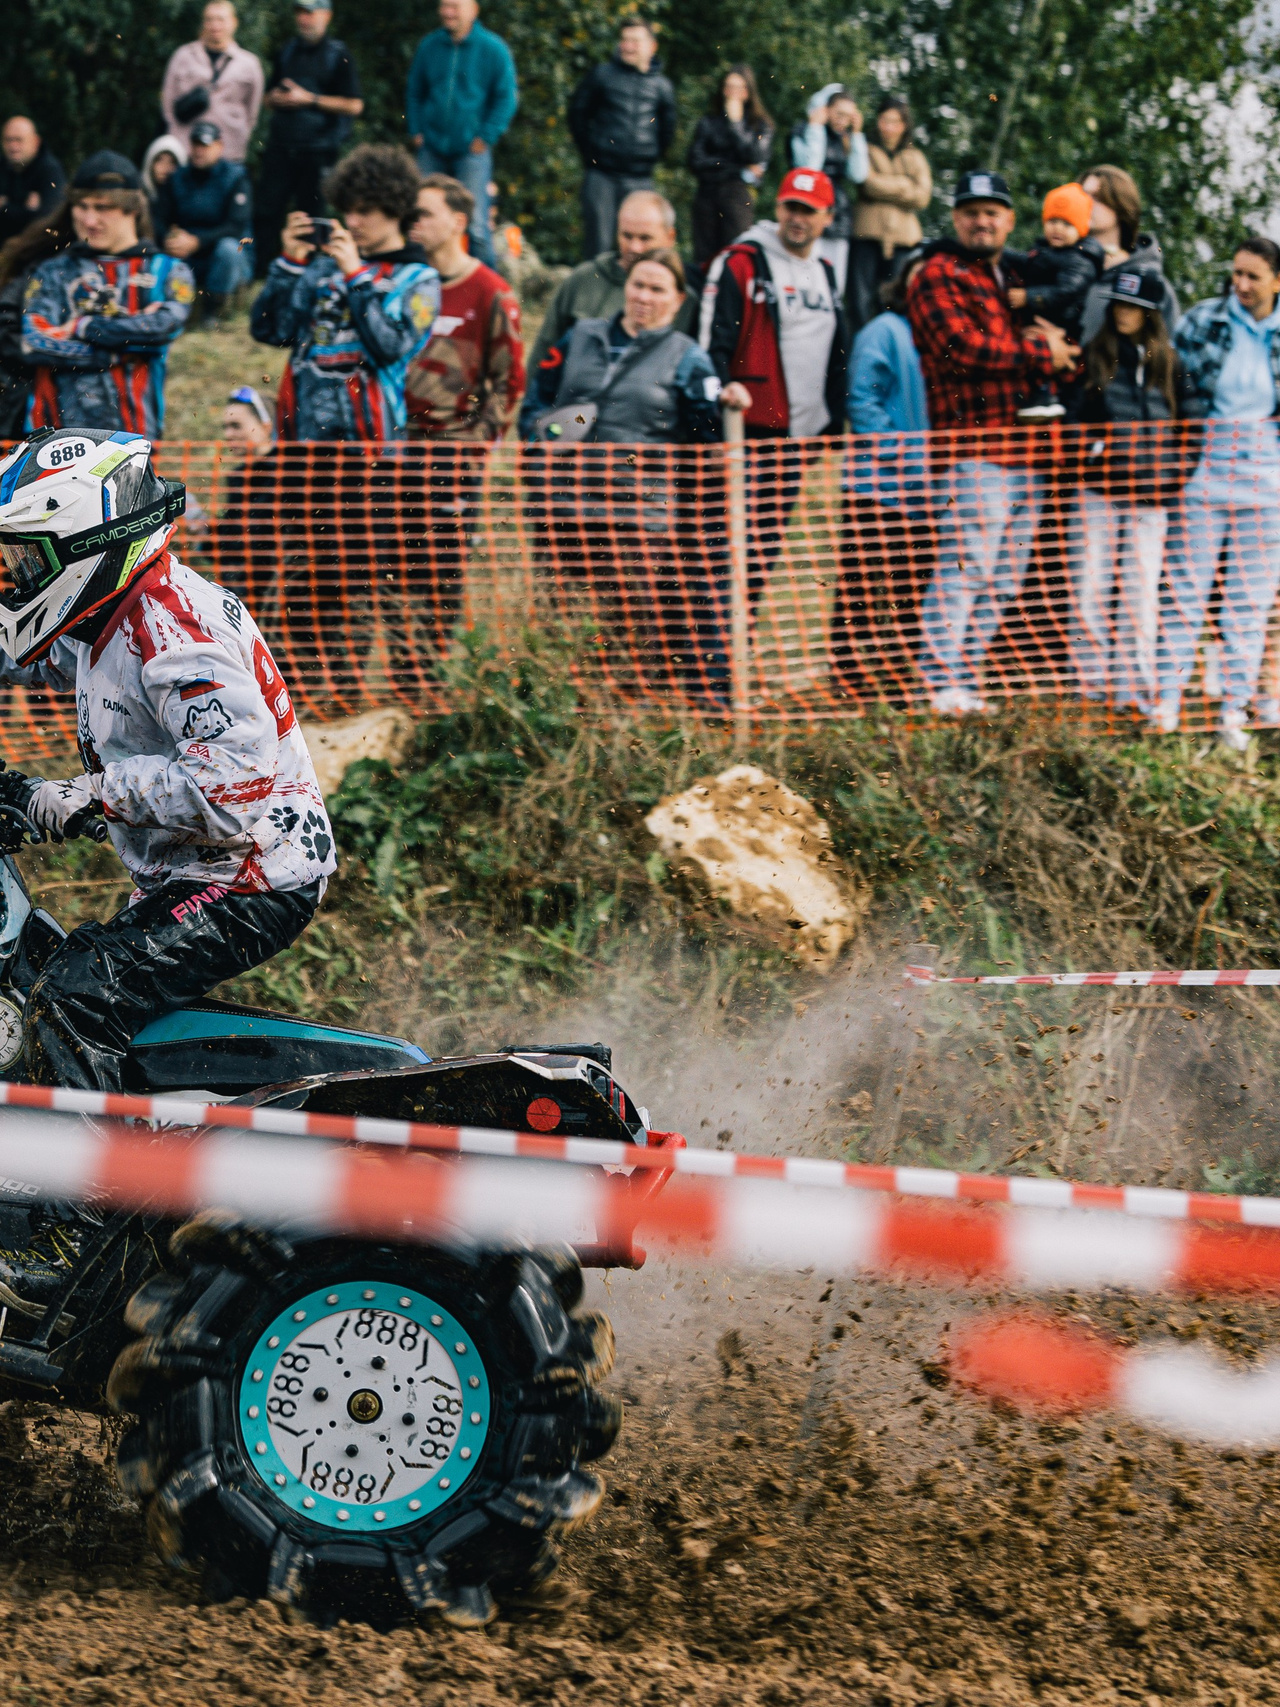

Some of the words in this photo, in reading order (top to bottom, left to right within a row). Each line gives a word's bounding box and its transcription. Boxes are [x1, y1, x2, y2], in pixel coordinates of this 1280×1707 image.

[49, 442, 87, 467] 888
[353, 1308, 421, 1352] 888
[267, 1351, 311, 1419] 888
[419, 1393, 463, 1461] 888
[310, 1460, 377, 1504] 888
